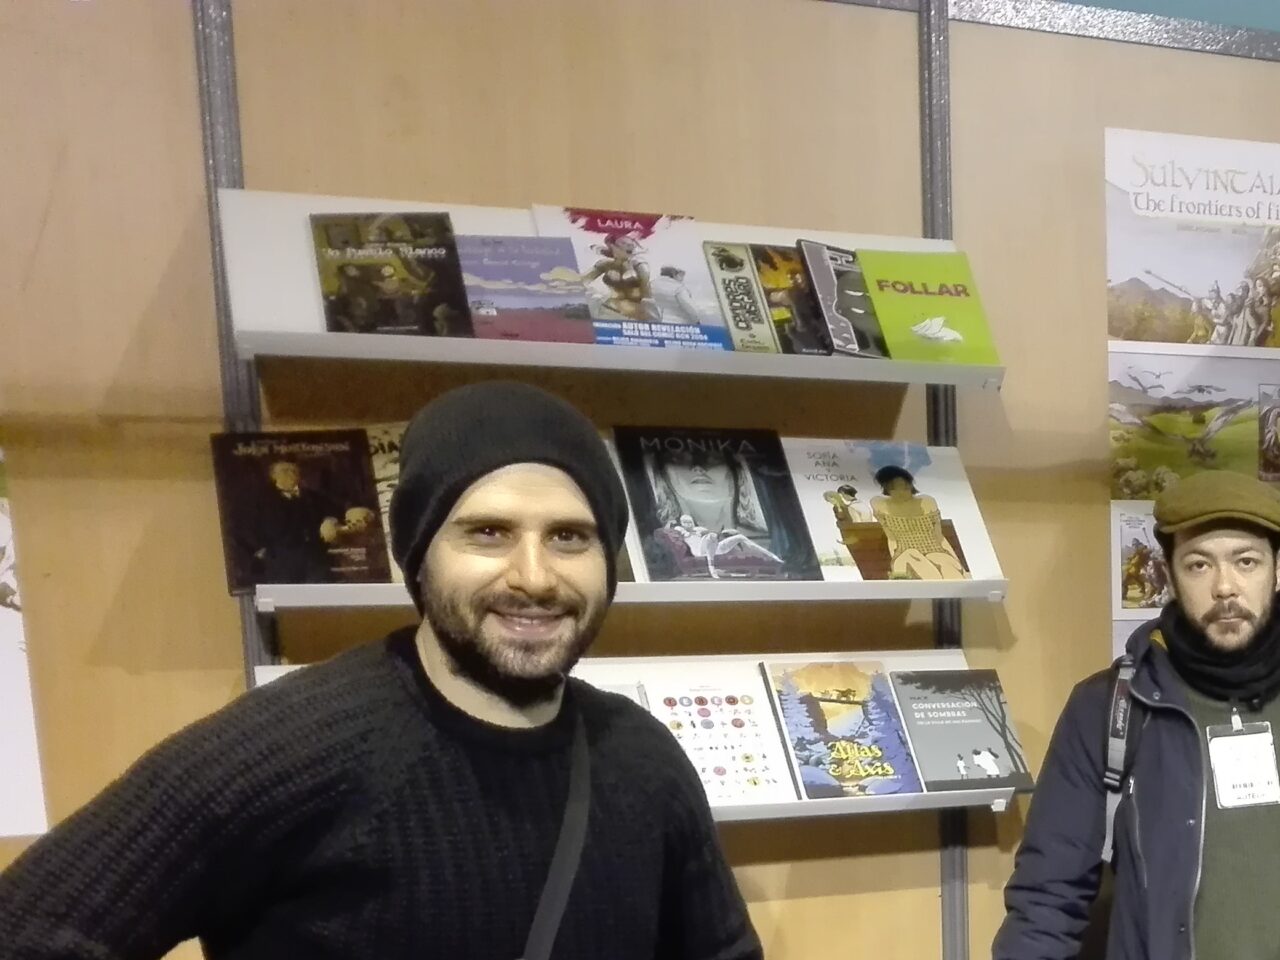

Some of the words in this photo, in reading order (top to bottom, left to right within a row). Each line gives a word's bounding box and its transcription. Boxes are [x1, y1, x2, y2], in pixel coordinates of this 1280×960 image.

[1133, 192, 1166, 213] The
[1169, 193, 1243, 219] frontiers
[1245, 200, 1262, 220] of
[597, 218, 643, 230] LAURA
[876, 278, 970, 298] FOLLAR
[640, 436, 757, 454] MONIKA
